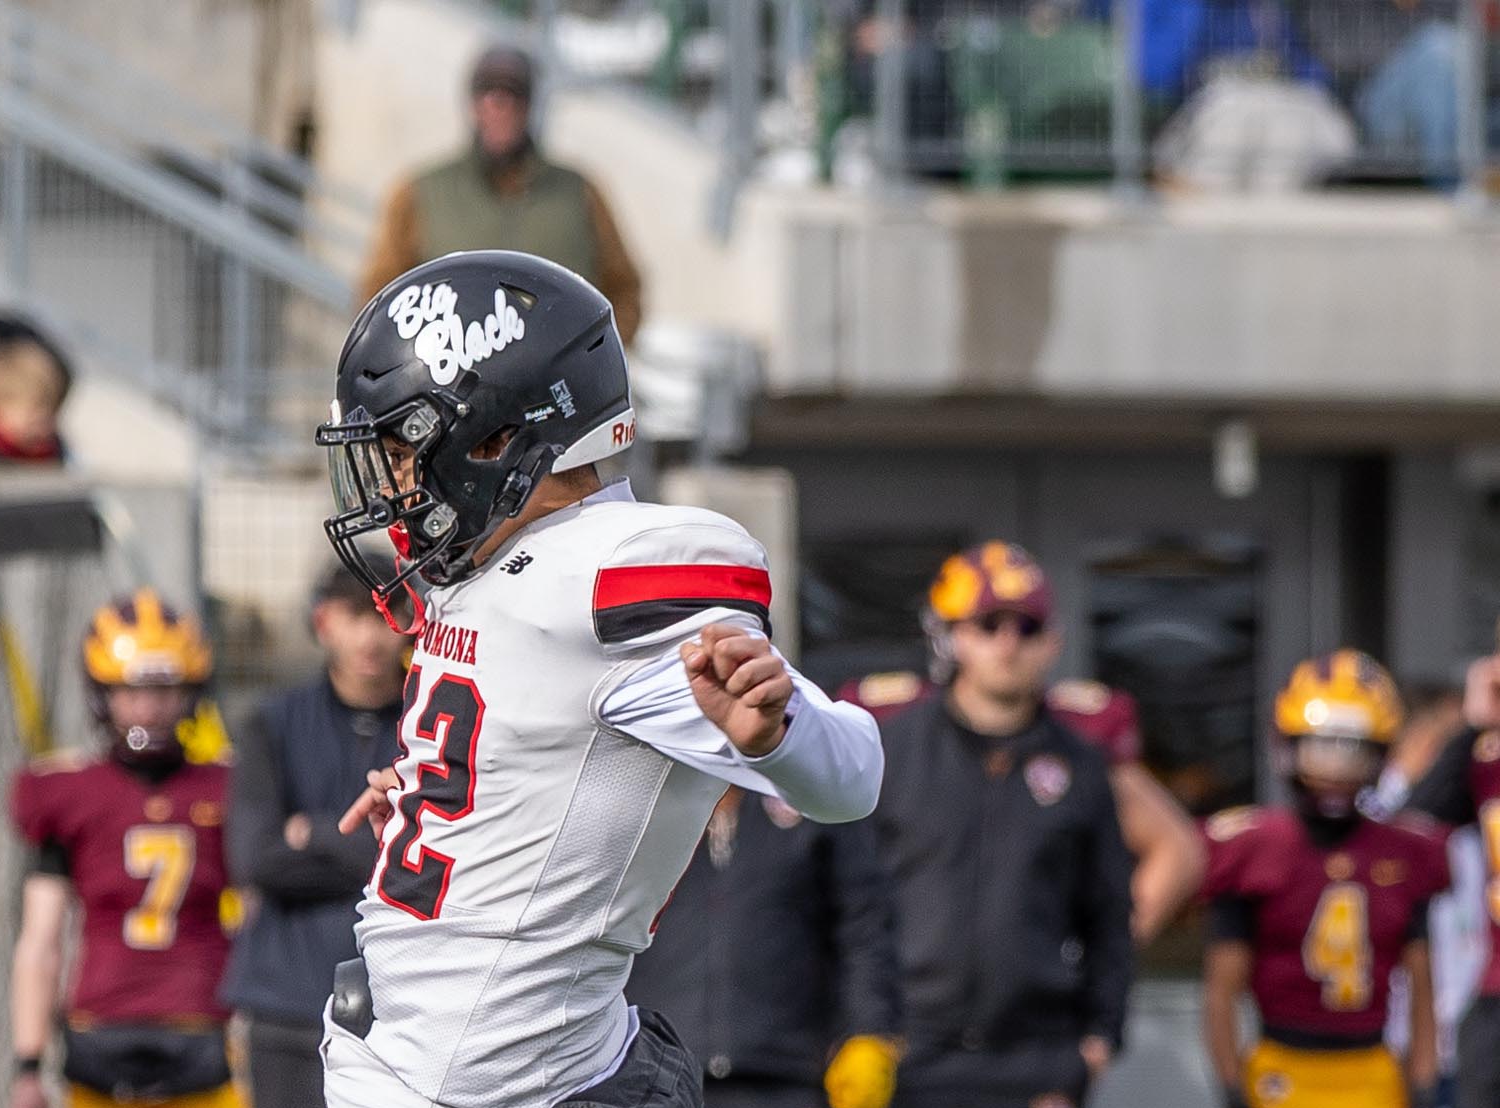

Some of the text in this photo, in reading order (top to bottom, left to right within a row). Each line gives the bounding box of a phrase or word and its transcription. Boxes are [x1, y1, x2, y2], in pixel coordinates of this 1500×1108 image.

[387, 283, 459, 340] Big
[414, 288, 526, 386] Black
[122, 824, 197, 950] 7
[1301, 879, 1375, 1013] 4
